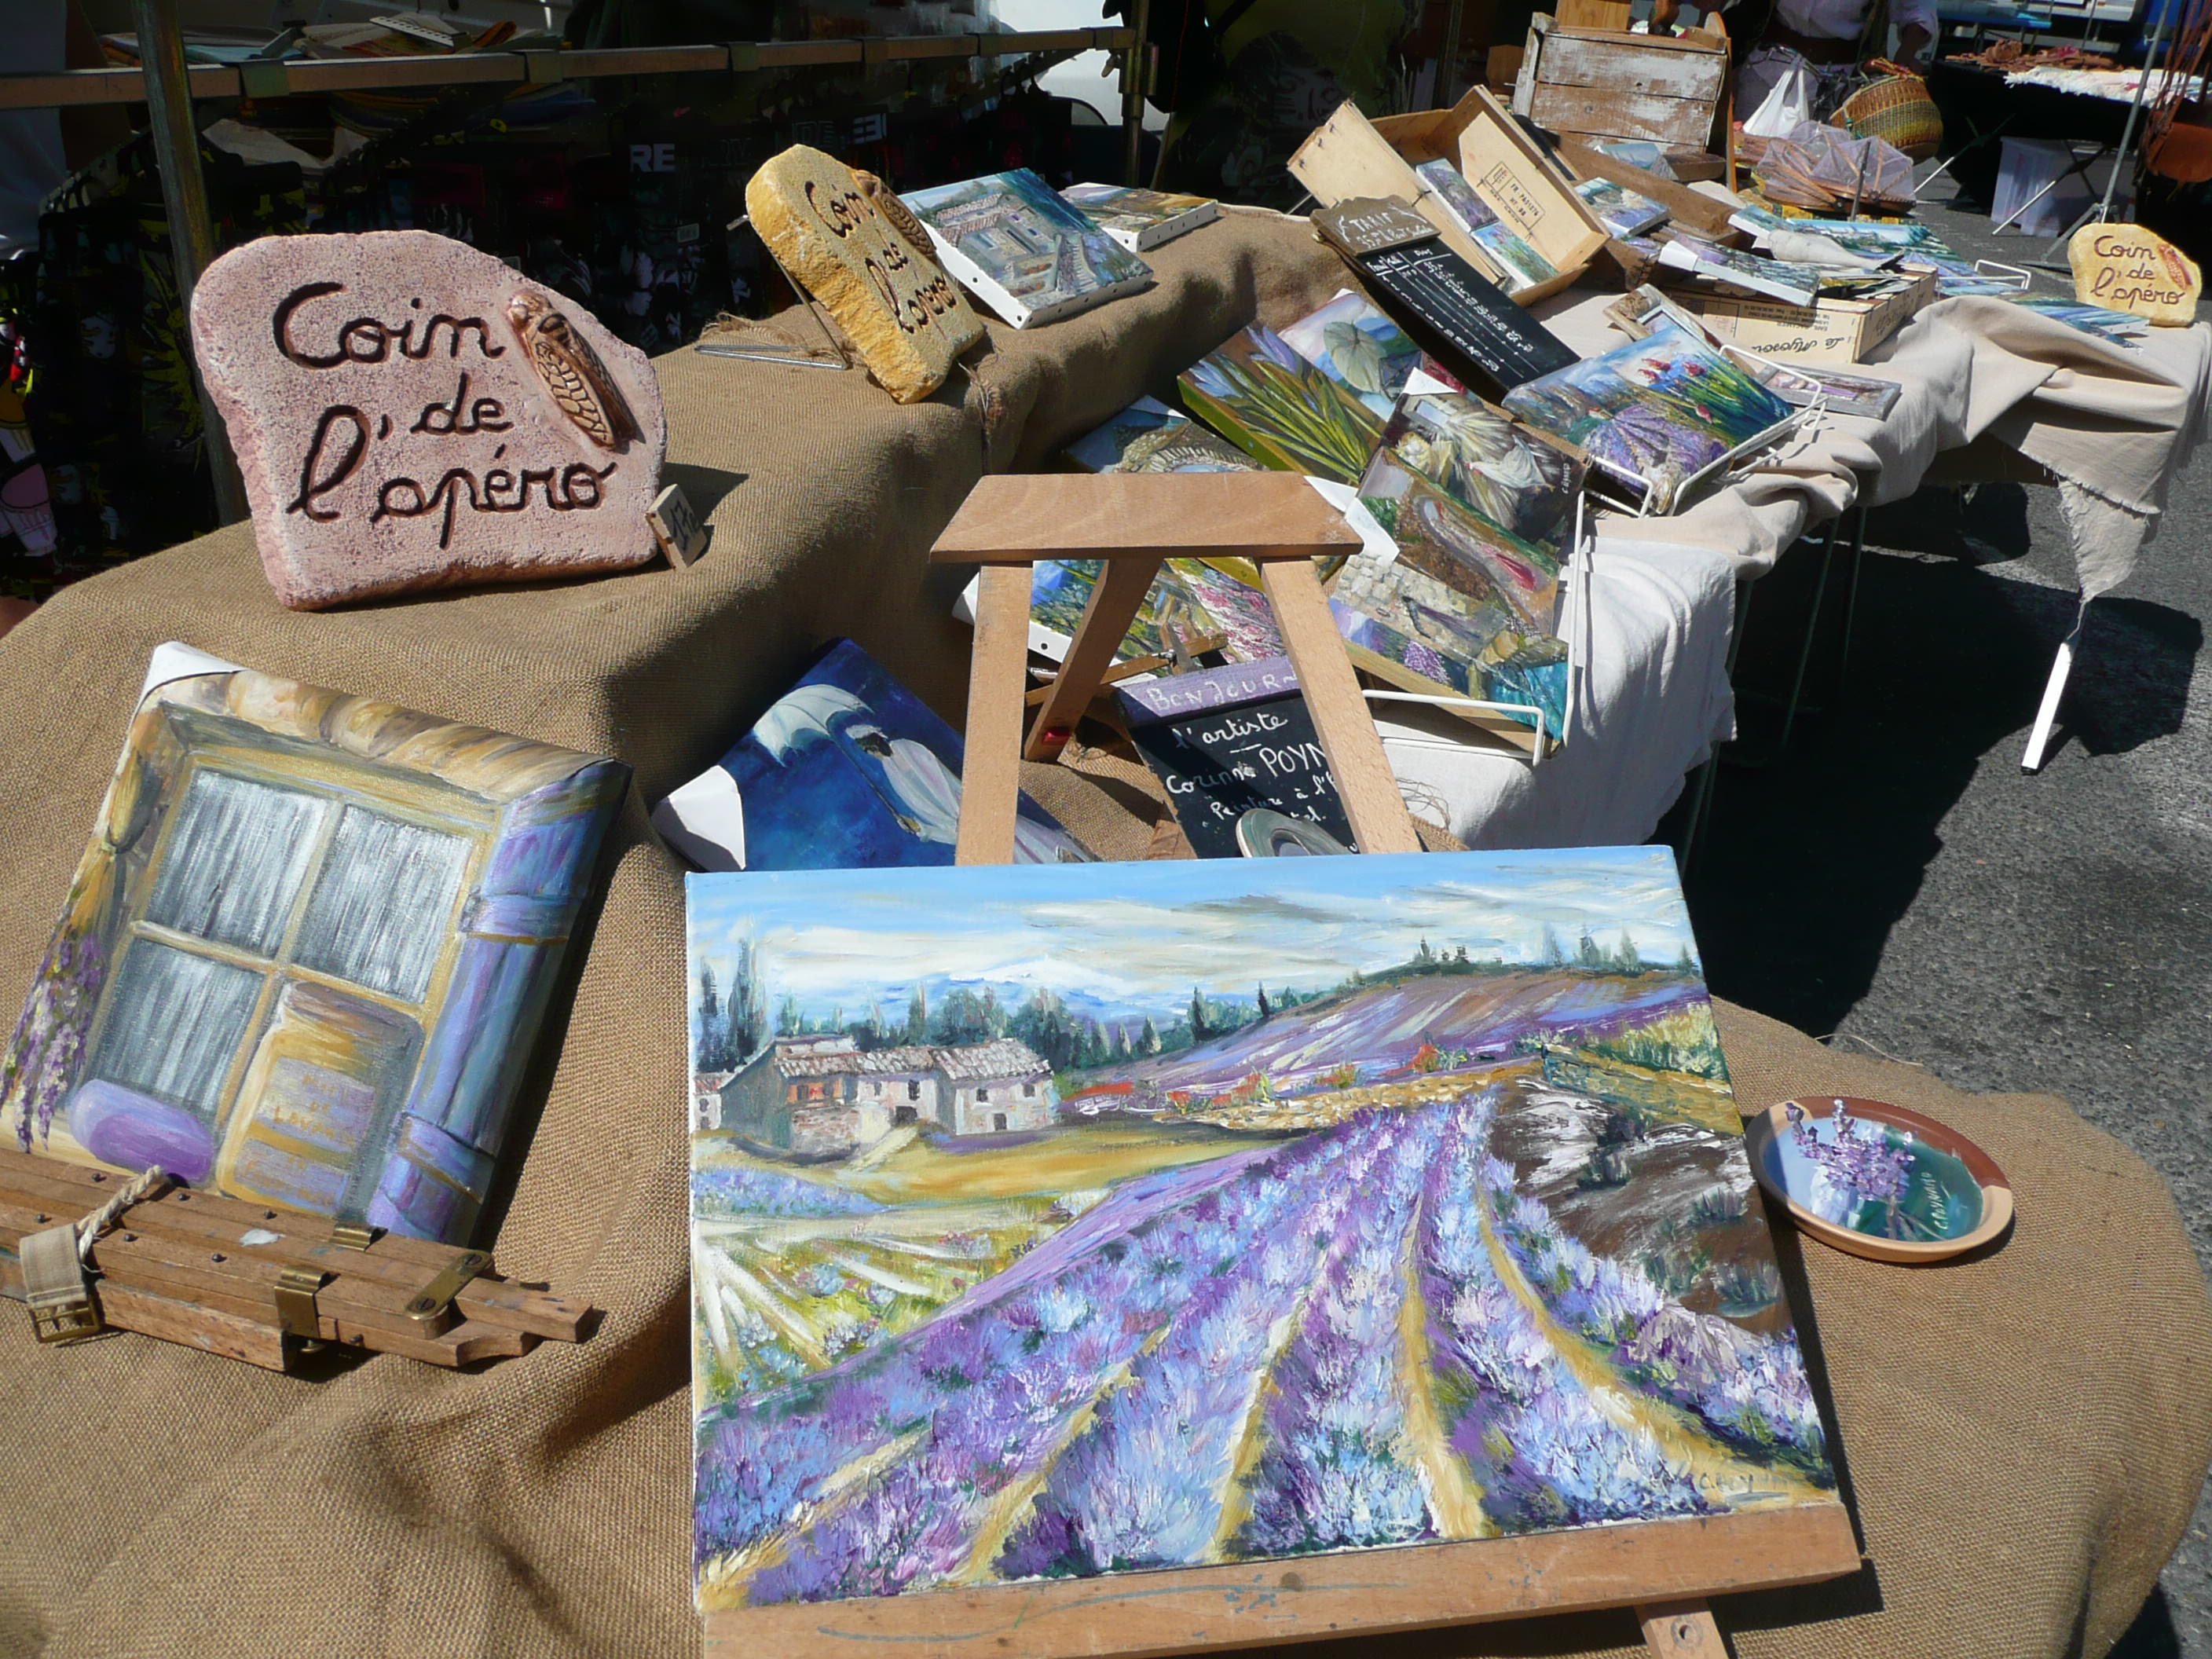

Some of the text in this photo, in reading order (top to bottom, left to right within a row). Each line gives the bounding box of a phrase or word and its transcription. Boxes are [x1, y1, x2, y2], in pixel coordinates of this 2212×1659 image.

[804, 180, 877, 238] Coin
[2094, 235, 2156, 260] Coin
[2126, 262, 2156, 280] de
[273, 281, 507, 370] Coin
[409, 372, 515, 436] de
